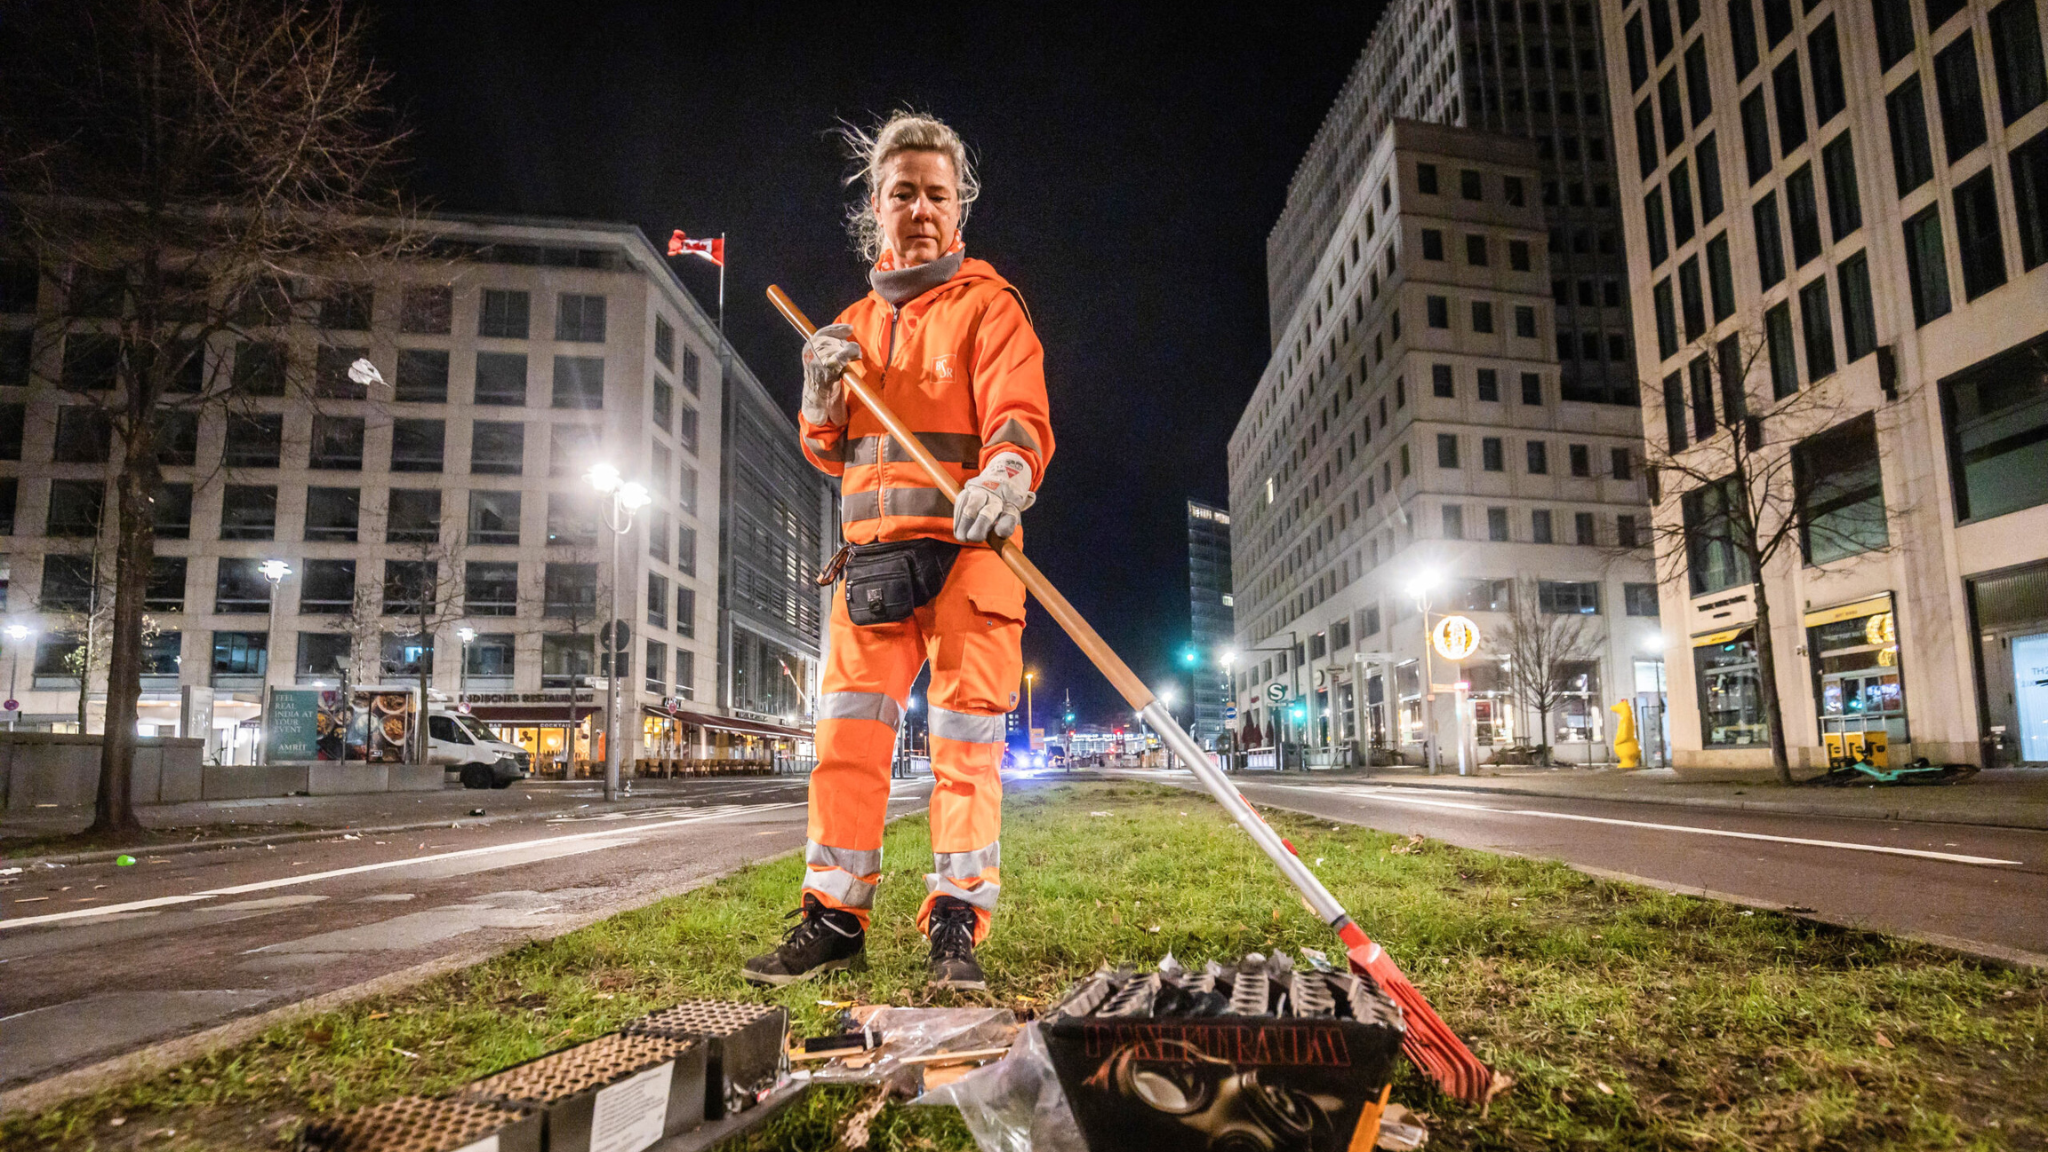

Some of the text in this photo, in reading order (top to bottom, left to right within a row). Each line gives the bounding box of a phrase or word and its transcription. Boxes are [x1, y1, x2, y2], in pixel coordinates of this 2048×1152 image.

[936, 359, 953, 378] BSR
[1269, 685, 1284, 699] S
[275, 694, 293, 702] FEEL
[275, 702, 296, 710] REAL
